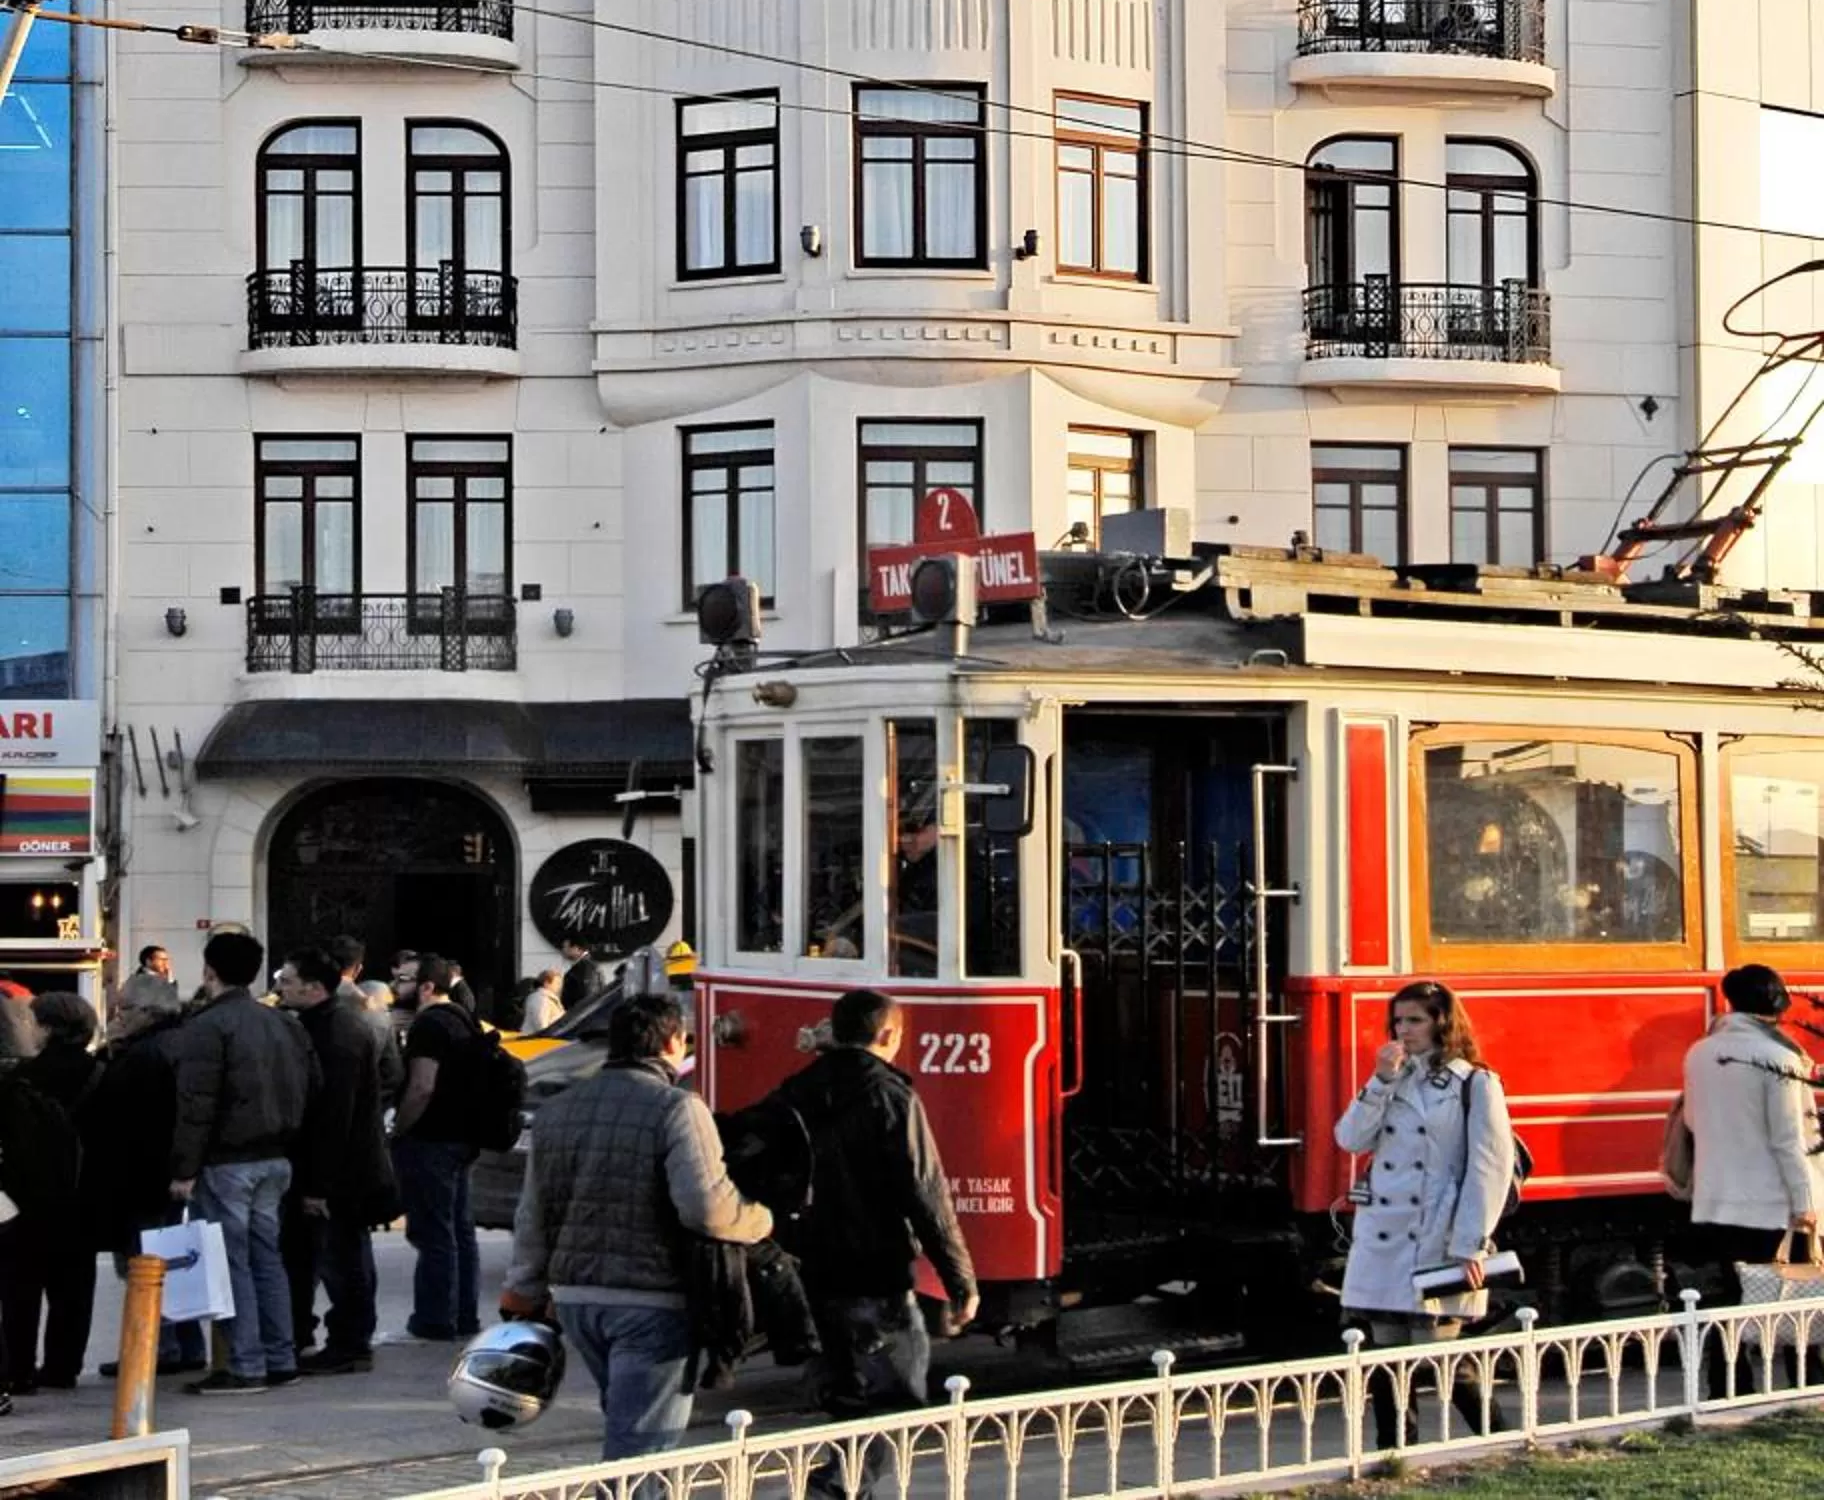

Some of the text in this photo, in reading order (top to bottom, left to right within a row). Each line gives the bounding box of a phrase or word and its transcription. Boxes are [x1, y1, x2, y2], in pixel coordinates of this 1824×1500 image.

[937, 493, 952, 530] 2
[878, 564, 912, 597] TAK
[919, 1033, 991, 1073] 223
